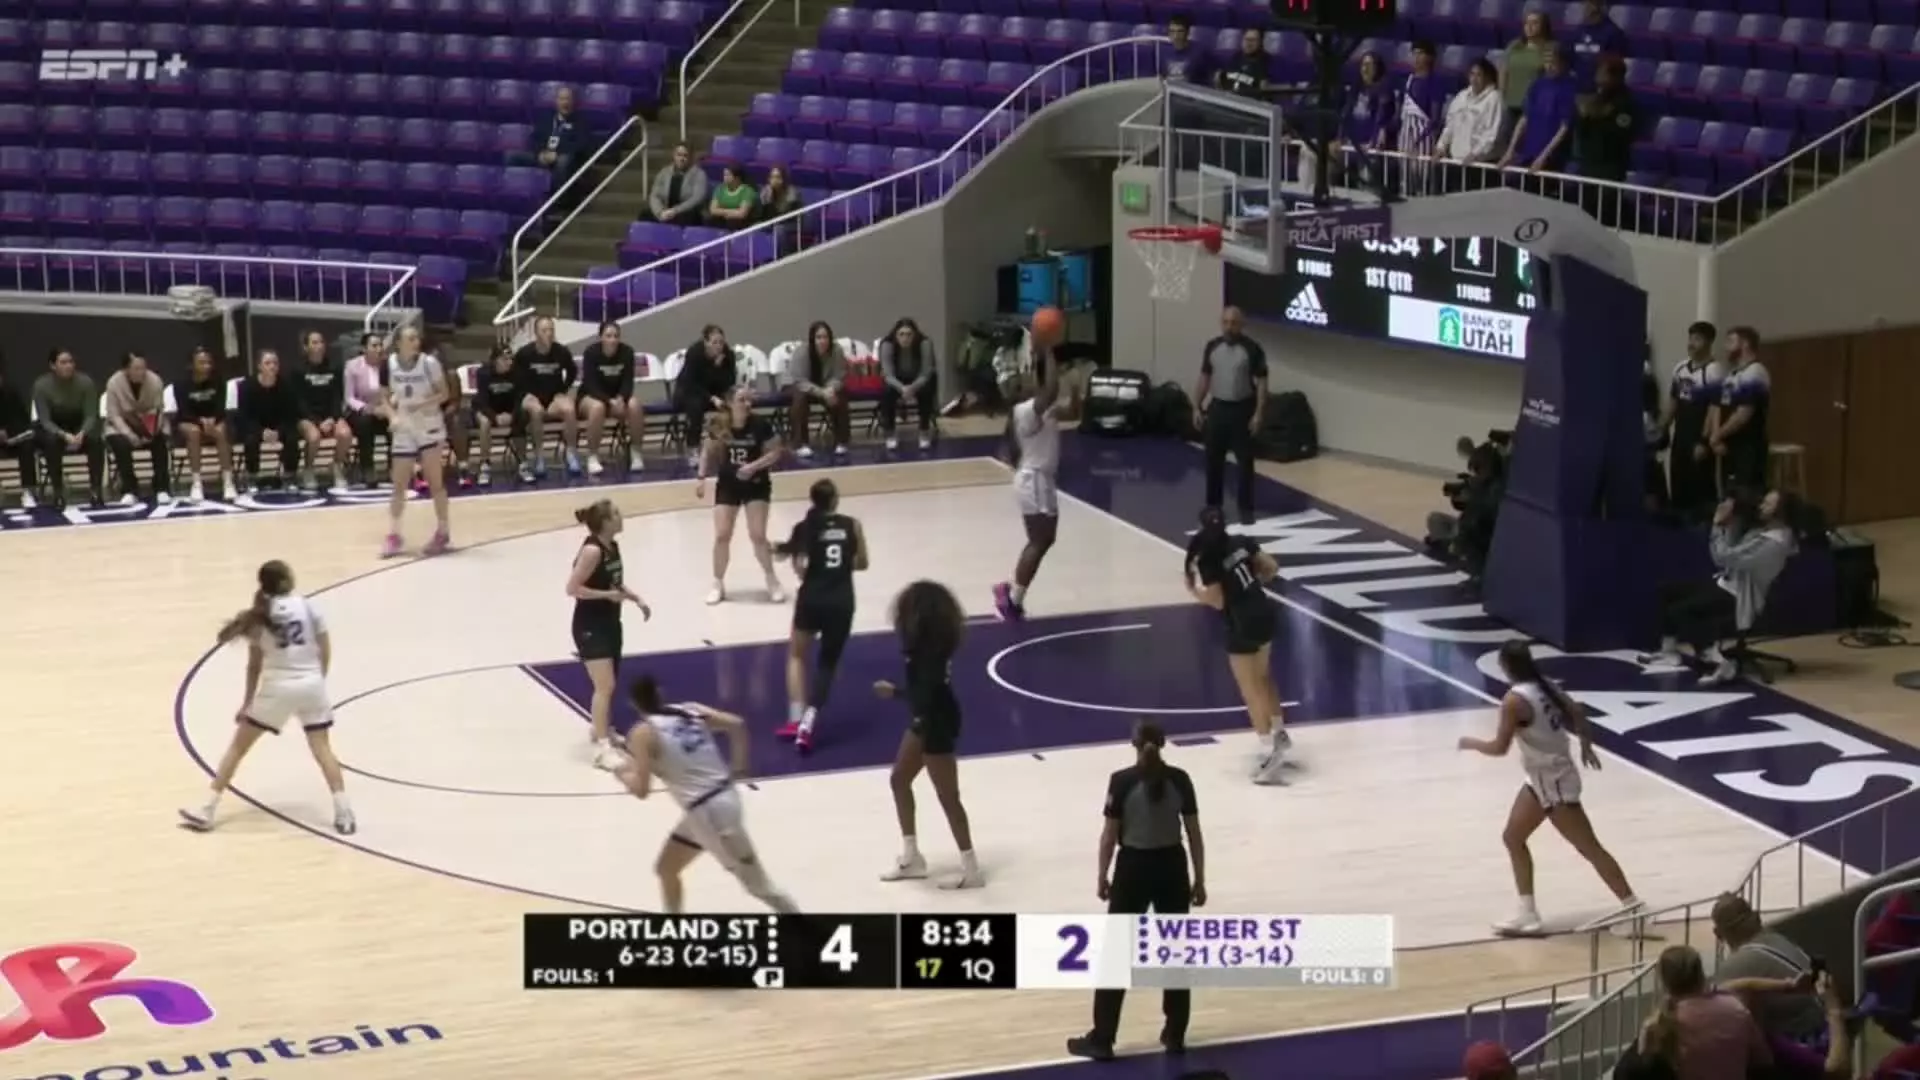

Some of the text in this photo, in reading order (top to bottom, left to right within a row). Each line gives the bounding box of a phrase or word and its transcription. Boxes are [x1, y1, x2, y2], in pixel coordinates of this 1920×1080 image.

[1332, 222, 1383, 242] FIRST
[1284, 306, 1328, 326] adidas
[1462, 312, 1512, 331] BANK OF
[1463, 328, 1513, 353] UTAH
[729, 447, 748, 465] 12
[826, 544, 842, 569] 9
[1234, 562, 1255, 590] 11
